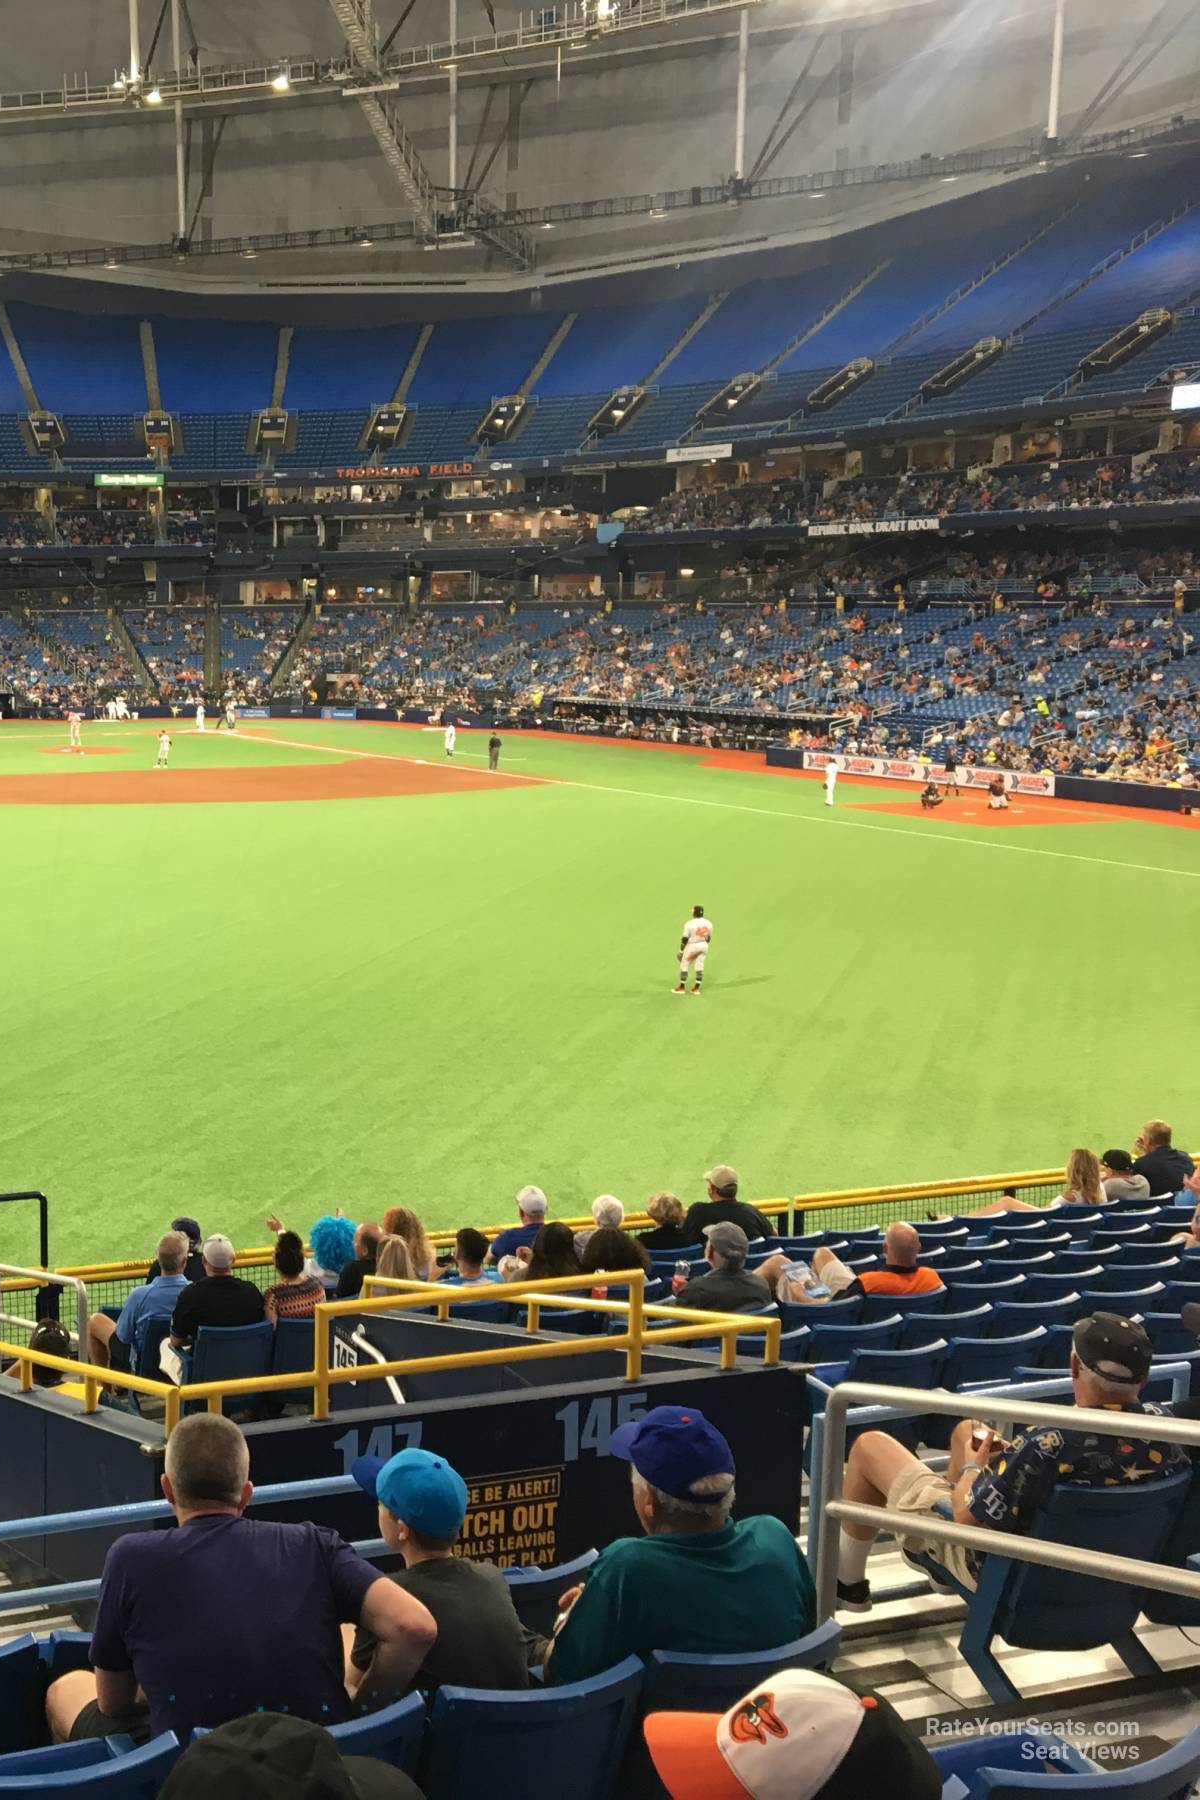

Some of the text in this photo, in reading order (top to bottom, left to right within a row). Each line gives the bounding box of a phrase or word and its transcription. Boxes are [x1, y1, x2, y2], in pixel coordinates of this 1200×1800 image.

[336, 466, 421, 480] TROPICANA
[429, 463, 473, 475] FIELD
[808, 518, 940, 537] REPUBLIC BANK DRAFT ROOM
[336, 1343, 356, 1369] 145
[484, 1486, 503, 1503] BE
[507, 1477, 557, 1499] ALERT!
[983, 1484, 1009, 1520] TB
[462, 1502, 558, 1539] TCH OUT
[500, 1530, 555, 1552] LEAVING
[498, 1554, 516, 1569] OF
[521, 1548, 556, 1567] PLAY
